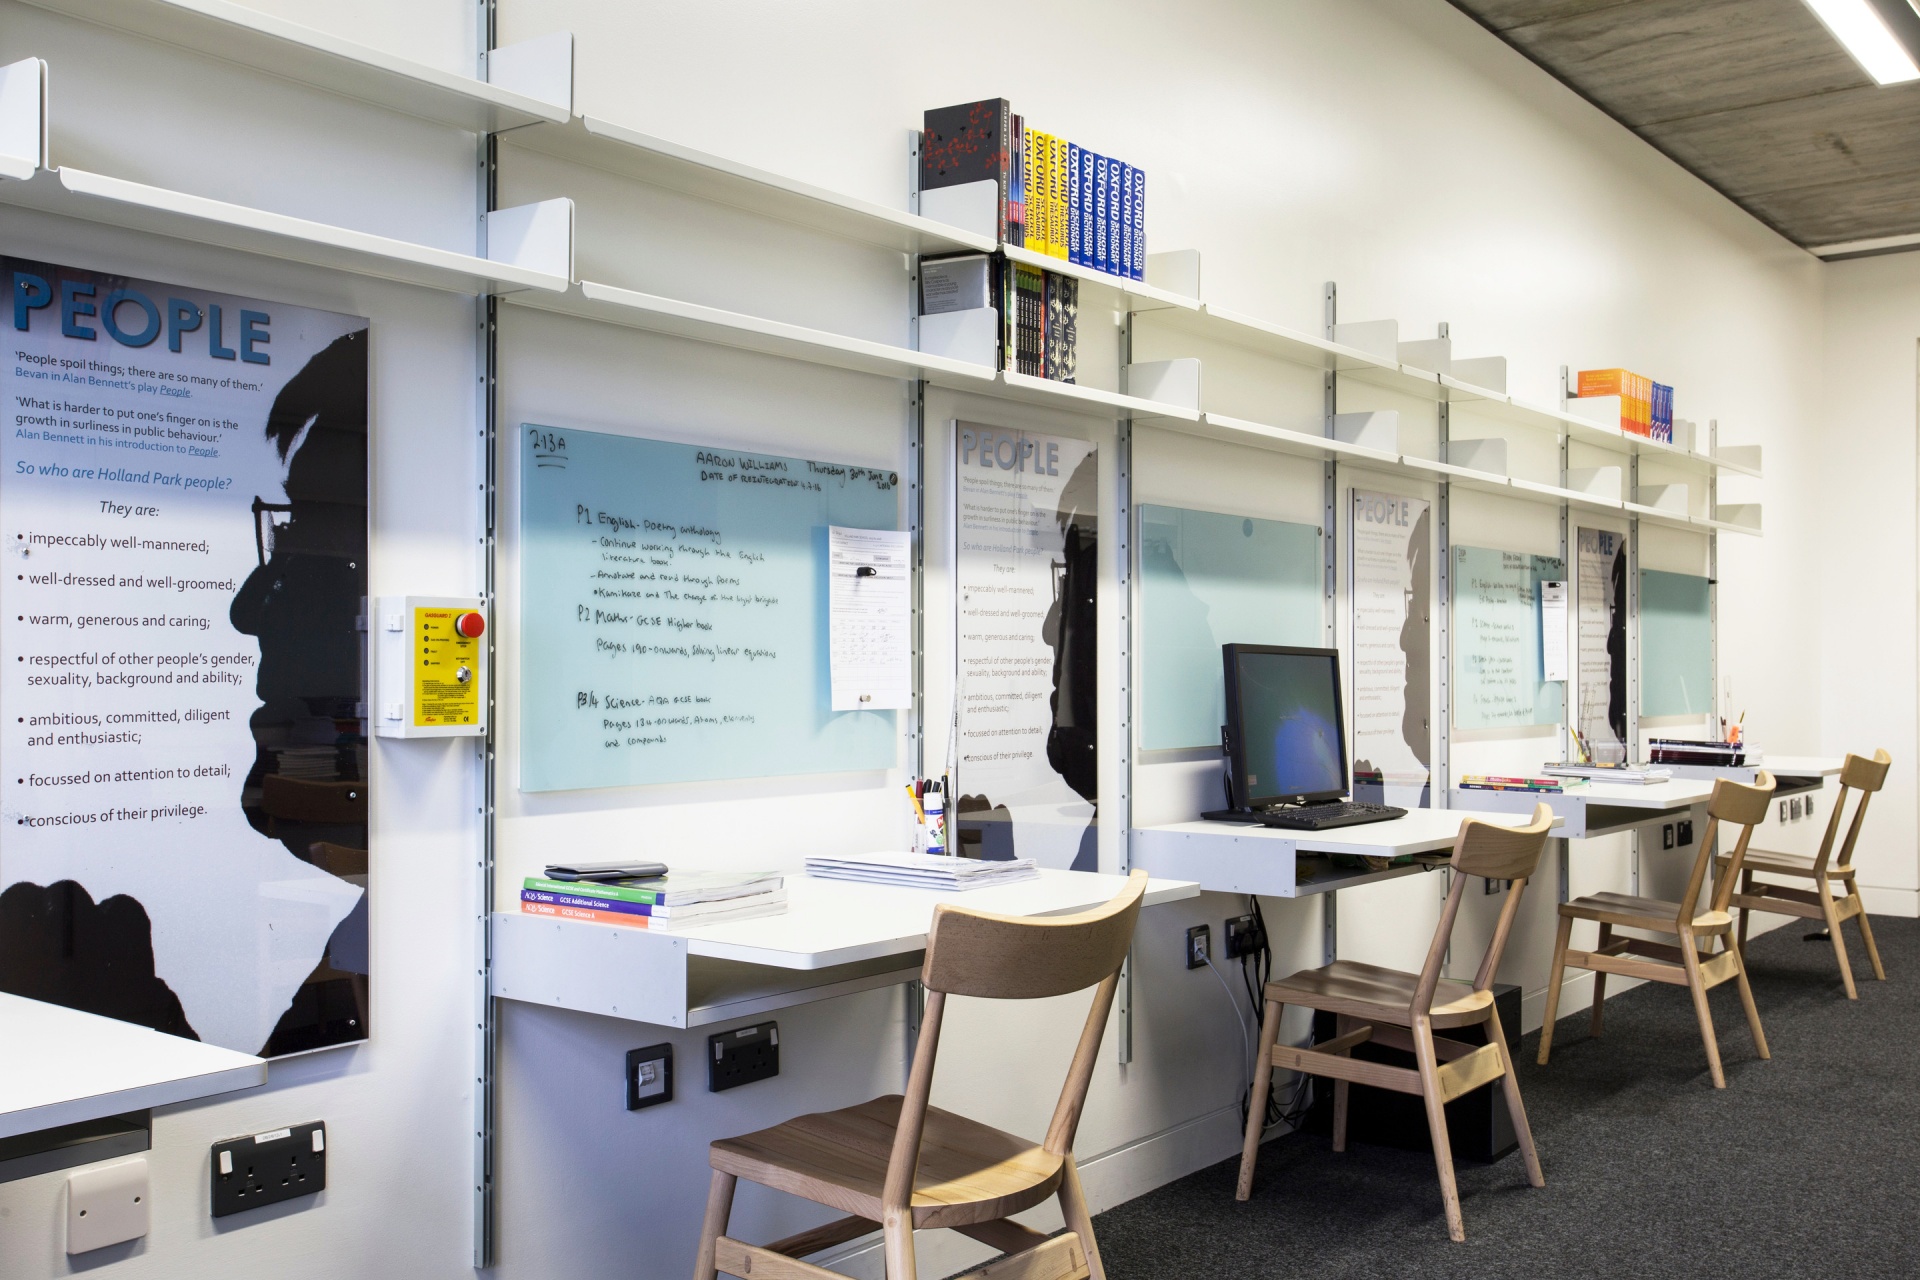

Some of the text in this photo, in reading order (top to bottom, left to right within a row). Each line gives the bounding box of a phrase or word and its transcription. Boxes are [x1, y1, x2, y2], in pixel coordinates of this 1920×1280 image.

[1070, 148, 1079, 208] OXFORD
[1084, 154, 1093, 213] OXFORD
[1097, 159, 1106, 217] OXFORD
[1110, 163, 1120, 220] OXFORD
[1124, 168, 1132, 224] OXFORD
[1134, 173, 1143, 228] OXFORD
[13, 271, 271, 365] PEOPLE
[15, 366, 49, 380] Bevan
[51, 371, 61, 381] in
[62, 373, 86, 384] Alan
[137, 382, 158, 395] play
[159, 384, 193, 399] People.
[60, 359, 86, 370] spoil
[88, 360, 125, 377] things;
[127, 365, 156, 379] there
[158, 372, 174, 381] are
[177, 374, 188, 383] so
[190, 376, 218, 389] many
[220, 378, 231, 388] of
[15, 415, 57, 427] growth
[60, 417, 70, 428] in
[72, 419, 120, 433] surliness
[122, 423, 132, 434] in
[134, 425, 165, 438] public
[53, 400, 62, 411] is
[64, 401, 101, 415] harder
[102, 406, 114, 417] to
[117, 410, 135, 420] put
[166, 412, 196, 427] finger
[197, 419, 210, 427] on
[213, 418, 220, 428] is
[222, 419, 239, 430] the
[15, 428, 221, 458] Alan Bennett in his introduction to People.
[962, 427, 1059, 476] PEOPLE
[696, 452, 788, 472] AARON WILLIAMS
[16, 460, 232, 492] So who are Holland Park people?
[700, 470, 738, 482] DATE OF
[807, 461, 845, 488] Thursday
[100, 500, 160, 518] They are:
[577, 504, 593, 529] P1
[1357, 495, 1409, 527] PEOPLE
[29, 531, 209, 555] impeccably well-mannered;
[641, 543, 674, 559] working
[1580, 533, 1613, 556] PEOPLE
[29, 572, 236, 593] well-dressed and well-groomed;
[29, 613, 210, 631] warm, generous and caring;
[578, 604, 590, 622] P2
[636, 615, 661, 626] GCSE
[596, 637, 627, 658] Pages
[30, 652, 98, 669] respectful
[101, 652, 116, 665] of
[118, 652, 154, 665] other
[210, 652, 255, 668] gender,
[27, 671, 242, 688] sexuality, background and ability;
[29, 708, 230, 727] ambitious, committed, diligent
[603, 719, 632, 732] Pages
[27, 730, 142, 747] and enthusiastic;
[967, 729, 990, 738] focussed
[998, 728, 1021, 736] attention
[1028, 726, 1043, 735] detail;
[29, 763, 231, 787] focussed on attention to detail;
[28, 804, 207, 827] conscious of their privilege.
[537, 892, 553, 902] Science
[559, 896, 609, 909] GCSE Additional Science
[538, 904, 555, 914] Science
[561, 908, 574, 916] GCSE
[574, 910, 590, 919] Science
